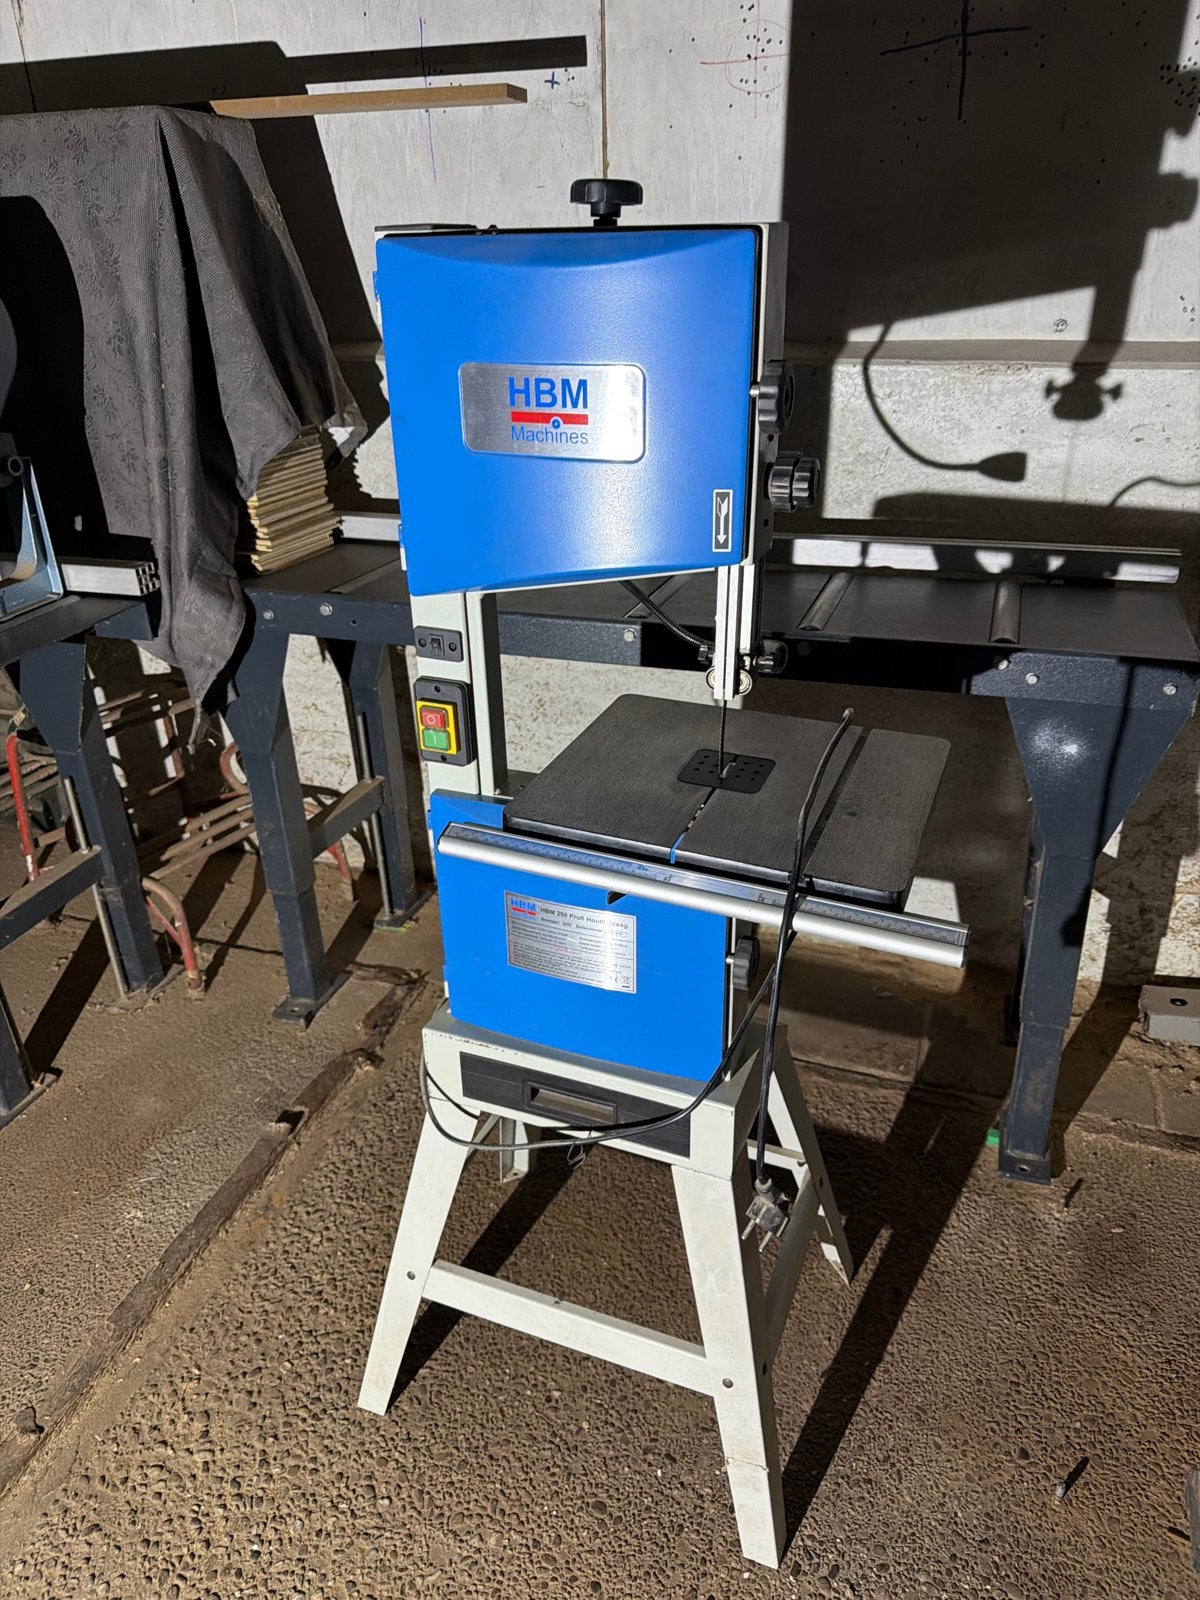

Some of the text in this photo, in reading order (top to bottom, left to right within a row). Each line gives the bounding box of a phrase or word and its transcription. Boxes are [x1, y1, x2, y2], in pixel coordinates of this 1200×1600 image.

[508, 376, 588, 409] HBM
[511, 425, 589, 444] Machines
[540, 907, 556, 916] HBM
[556, 910, 568, 918] 250
[569, 913, 585, 921] Profi
